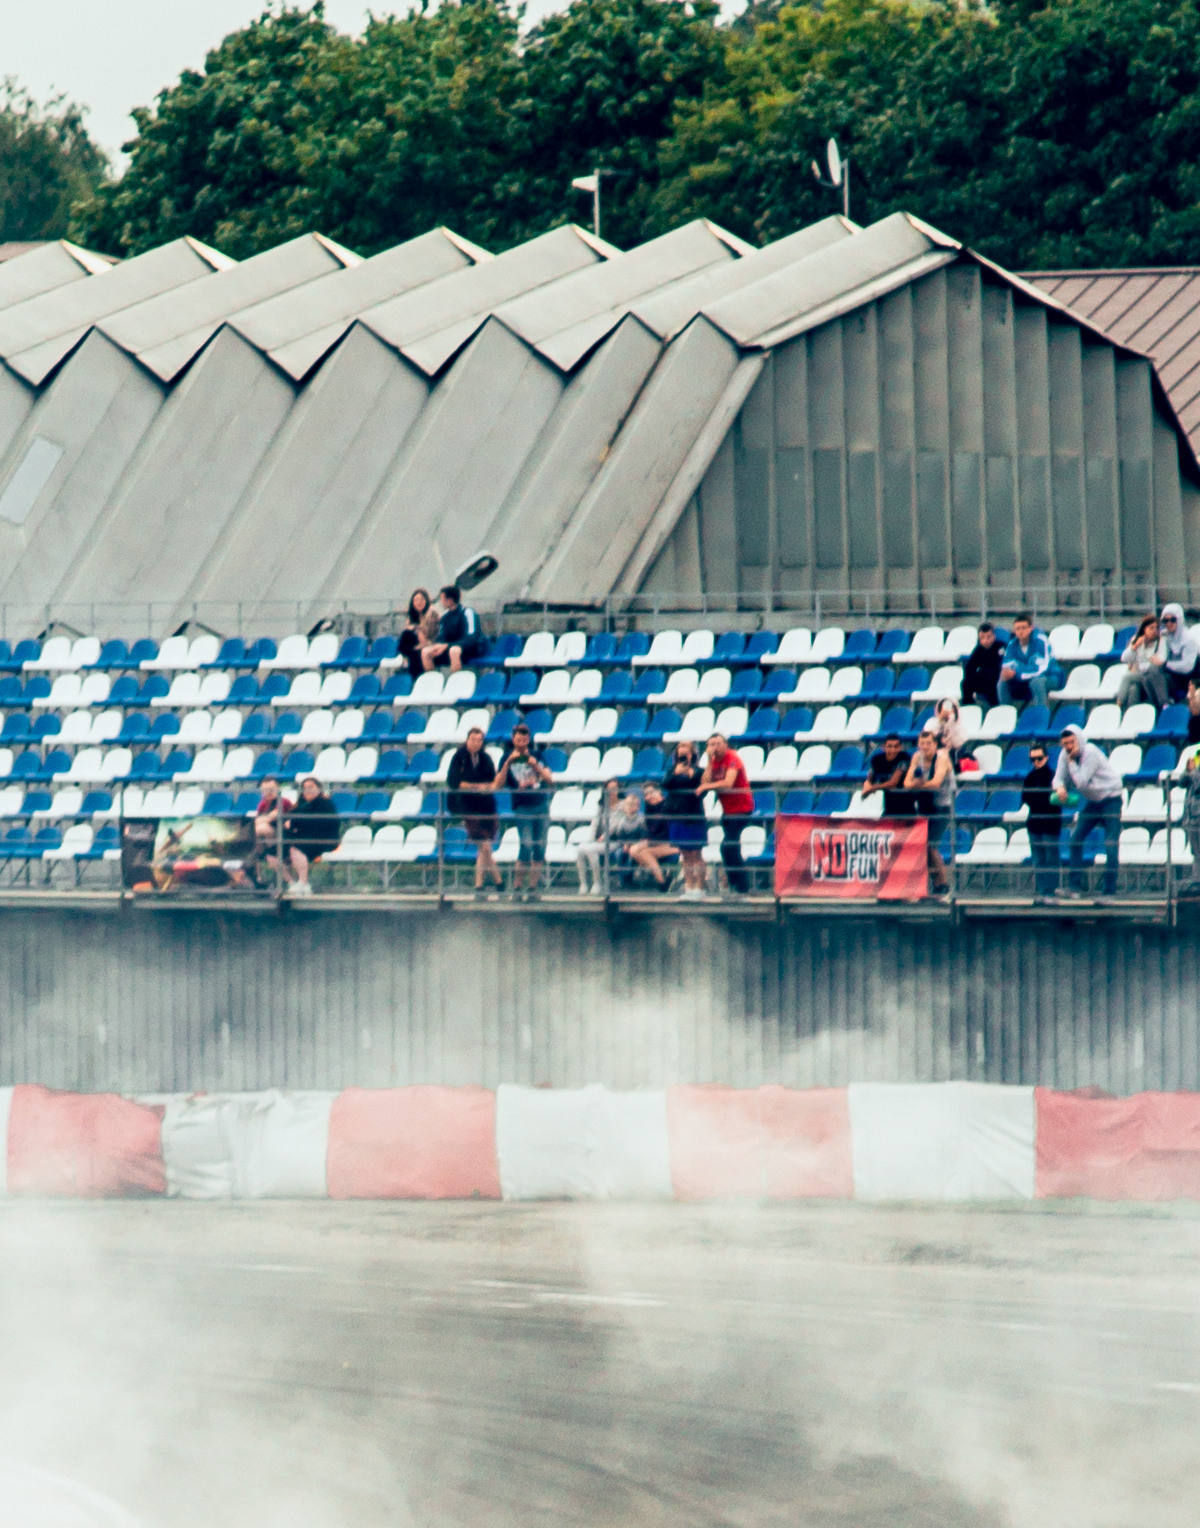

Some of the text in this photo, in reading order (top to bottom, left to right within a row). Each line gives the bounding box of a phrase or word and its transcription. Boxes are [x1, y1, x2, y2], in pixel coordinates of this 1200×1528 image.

[849, 833, 892, 855] DRIFT
[813, 833, 848, 879] NO
[849, 857, 879, 880] FUN
